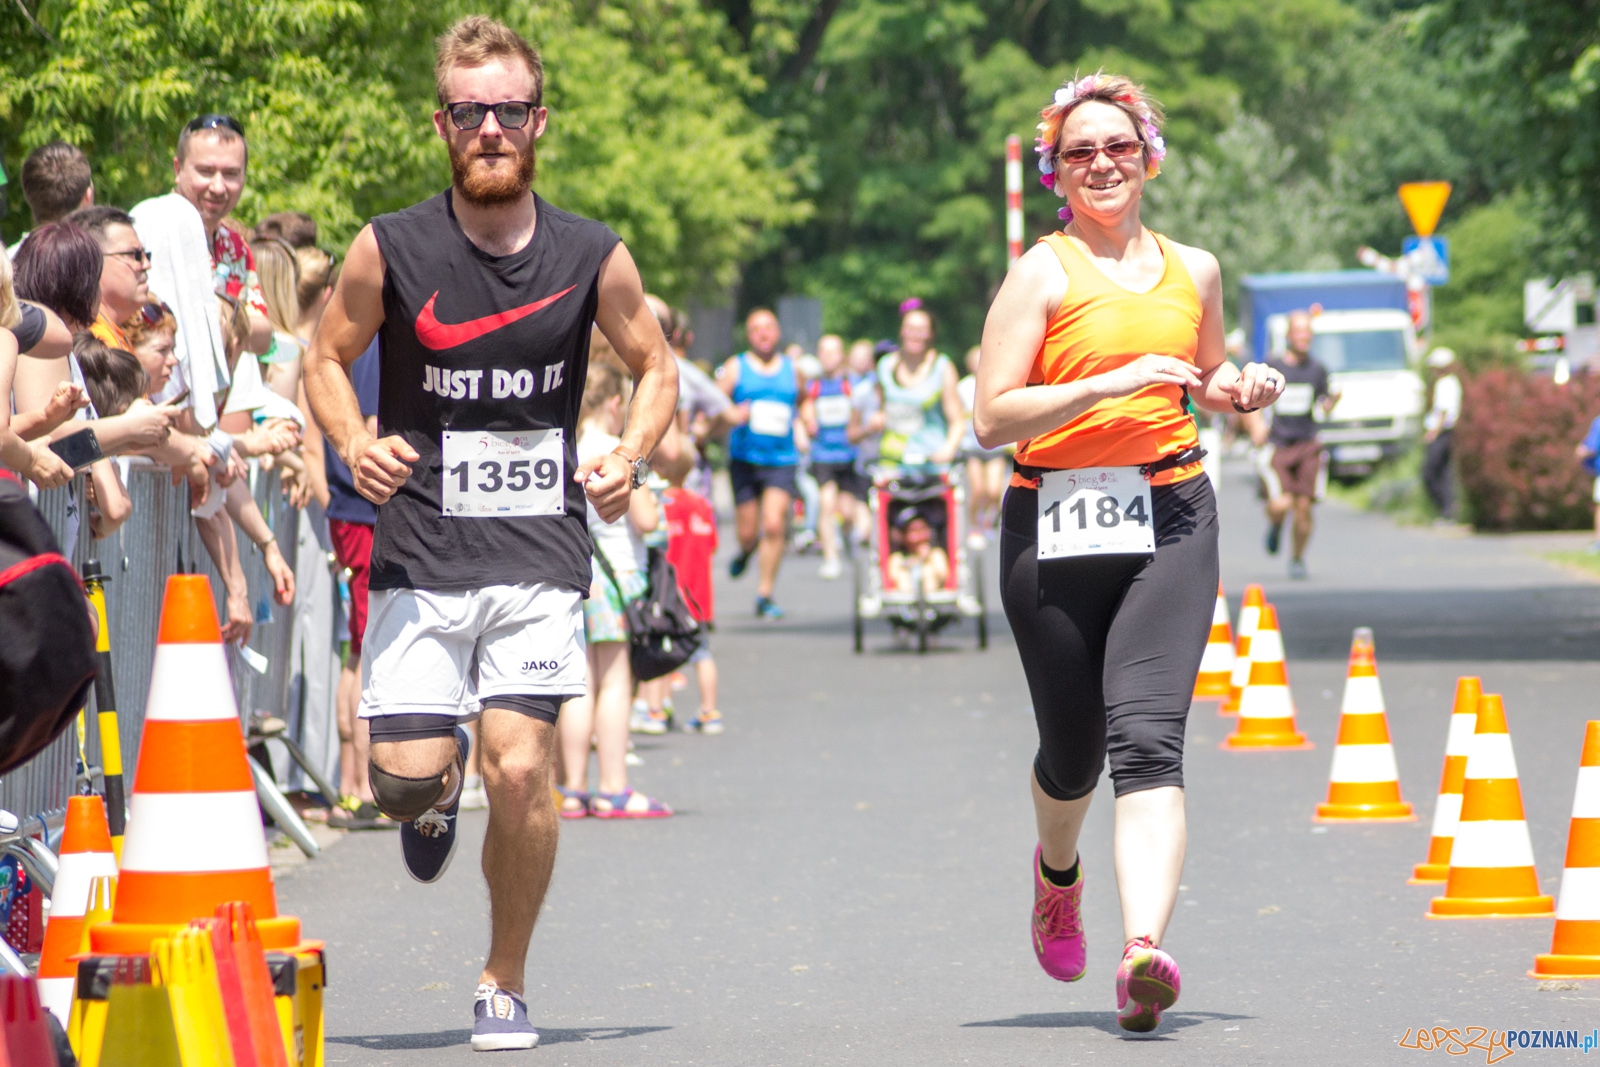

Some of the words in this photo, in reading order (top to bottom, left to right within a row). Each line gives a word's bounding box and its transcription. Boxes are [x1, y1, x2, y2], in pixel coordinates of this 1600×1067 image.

[423, 364, 484, 400] JUST
[492, 368, 534, 400] DO
[542, 360, 565, 394] IT.
[478, 436, 488, 456] 5
[491, 437, 512, 450] bieg
[450, 458, 559, 493] 1359
[1067, 474, 1076, 494] 5
[1078, 473, 1099, 485] bieg
[1044, 495, 1149, 533] 1184
[521, 660, 559, 671] JAKO
